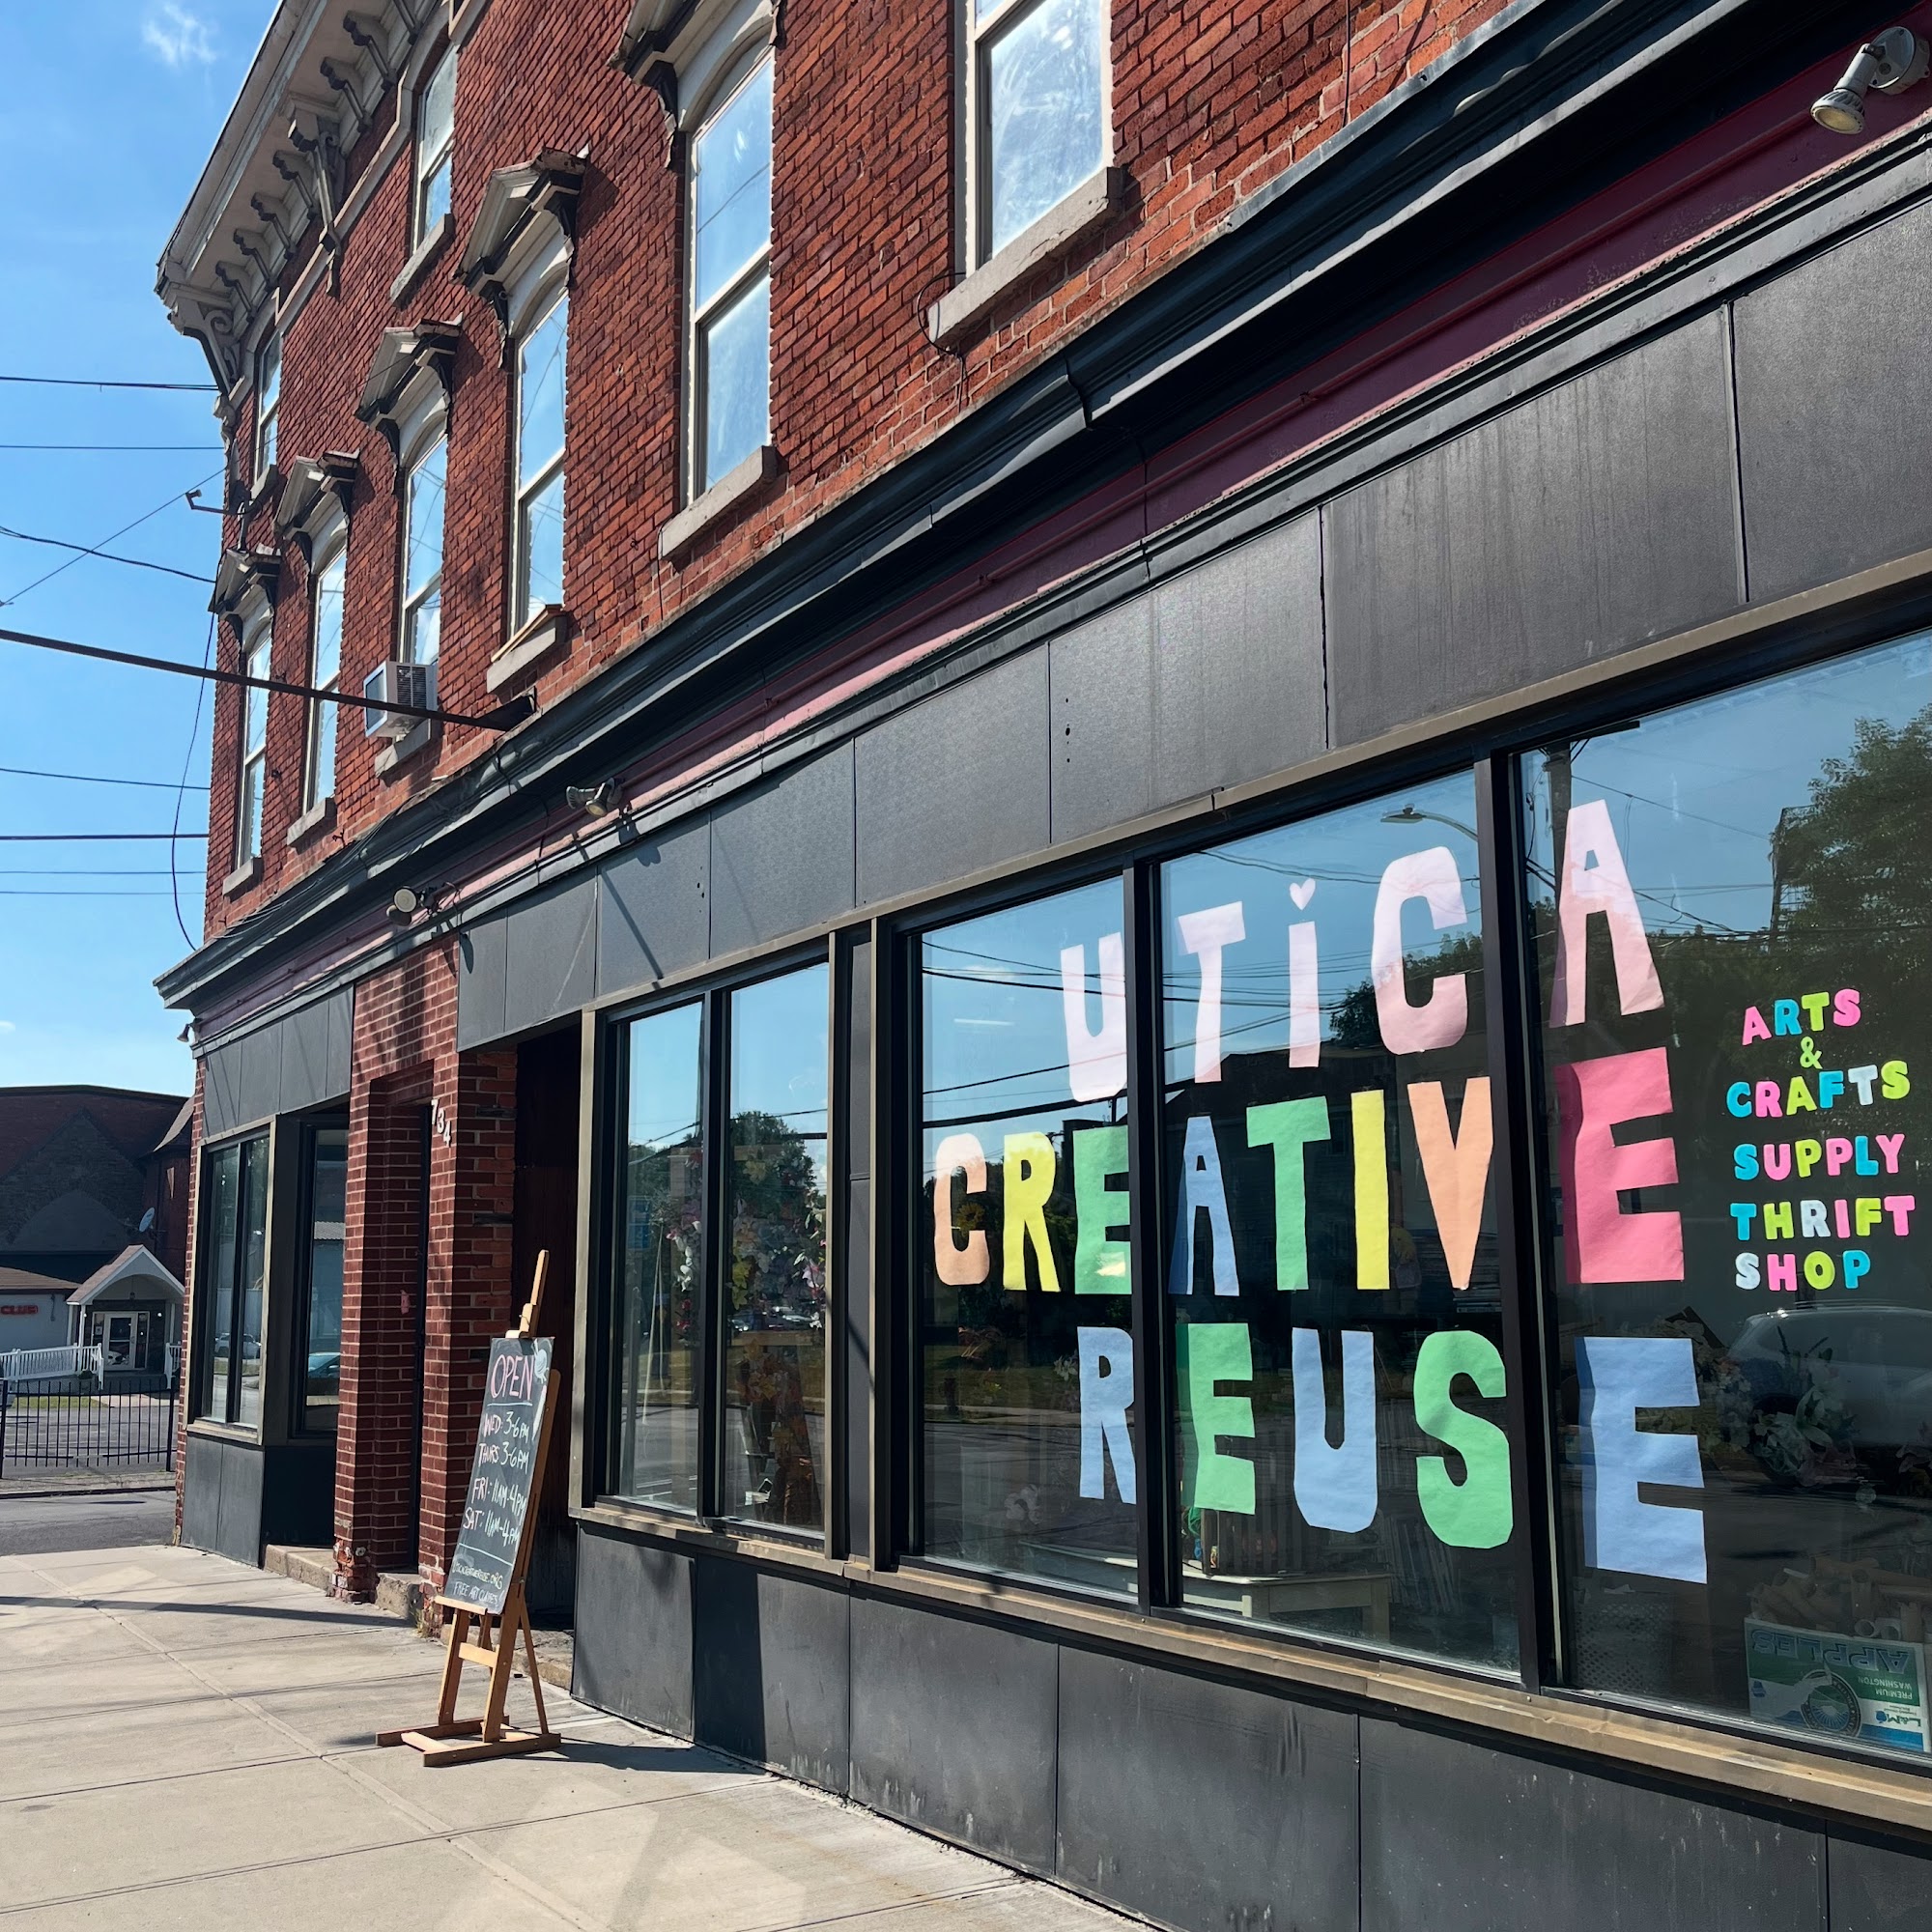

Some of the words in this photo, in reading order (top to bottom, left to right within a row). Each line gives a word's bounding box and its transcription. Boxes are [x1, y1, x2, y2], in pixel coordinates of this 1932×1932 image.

[1742, 989, 1861, 1045] ARTS
[1800, 1036, 1823, 1069] &
[1726, 1060, 1911, 1118] CRAFTS
[431, 1098, 451, 1148] 734
[933, 1047, 1684, 1296] CREATIVE
[1734, 1133, 1905, 1180] SUPPLY
[1730, 1195, 1916, 1240] THRIFT
[1735, 1250, 1871, 1292] SHOP
[491, 1354, 534, 1401] OPEN
[1077, 1322, 1708, 1584] REUSE
[1751, 1629, 1910, 1674] APPLES
[1859, 1676, 1912, 1690] WASHINGTON
[1875, 1688, 1913, 1700] PREMIUM
